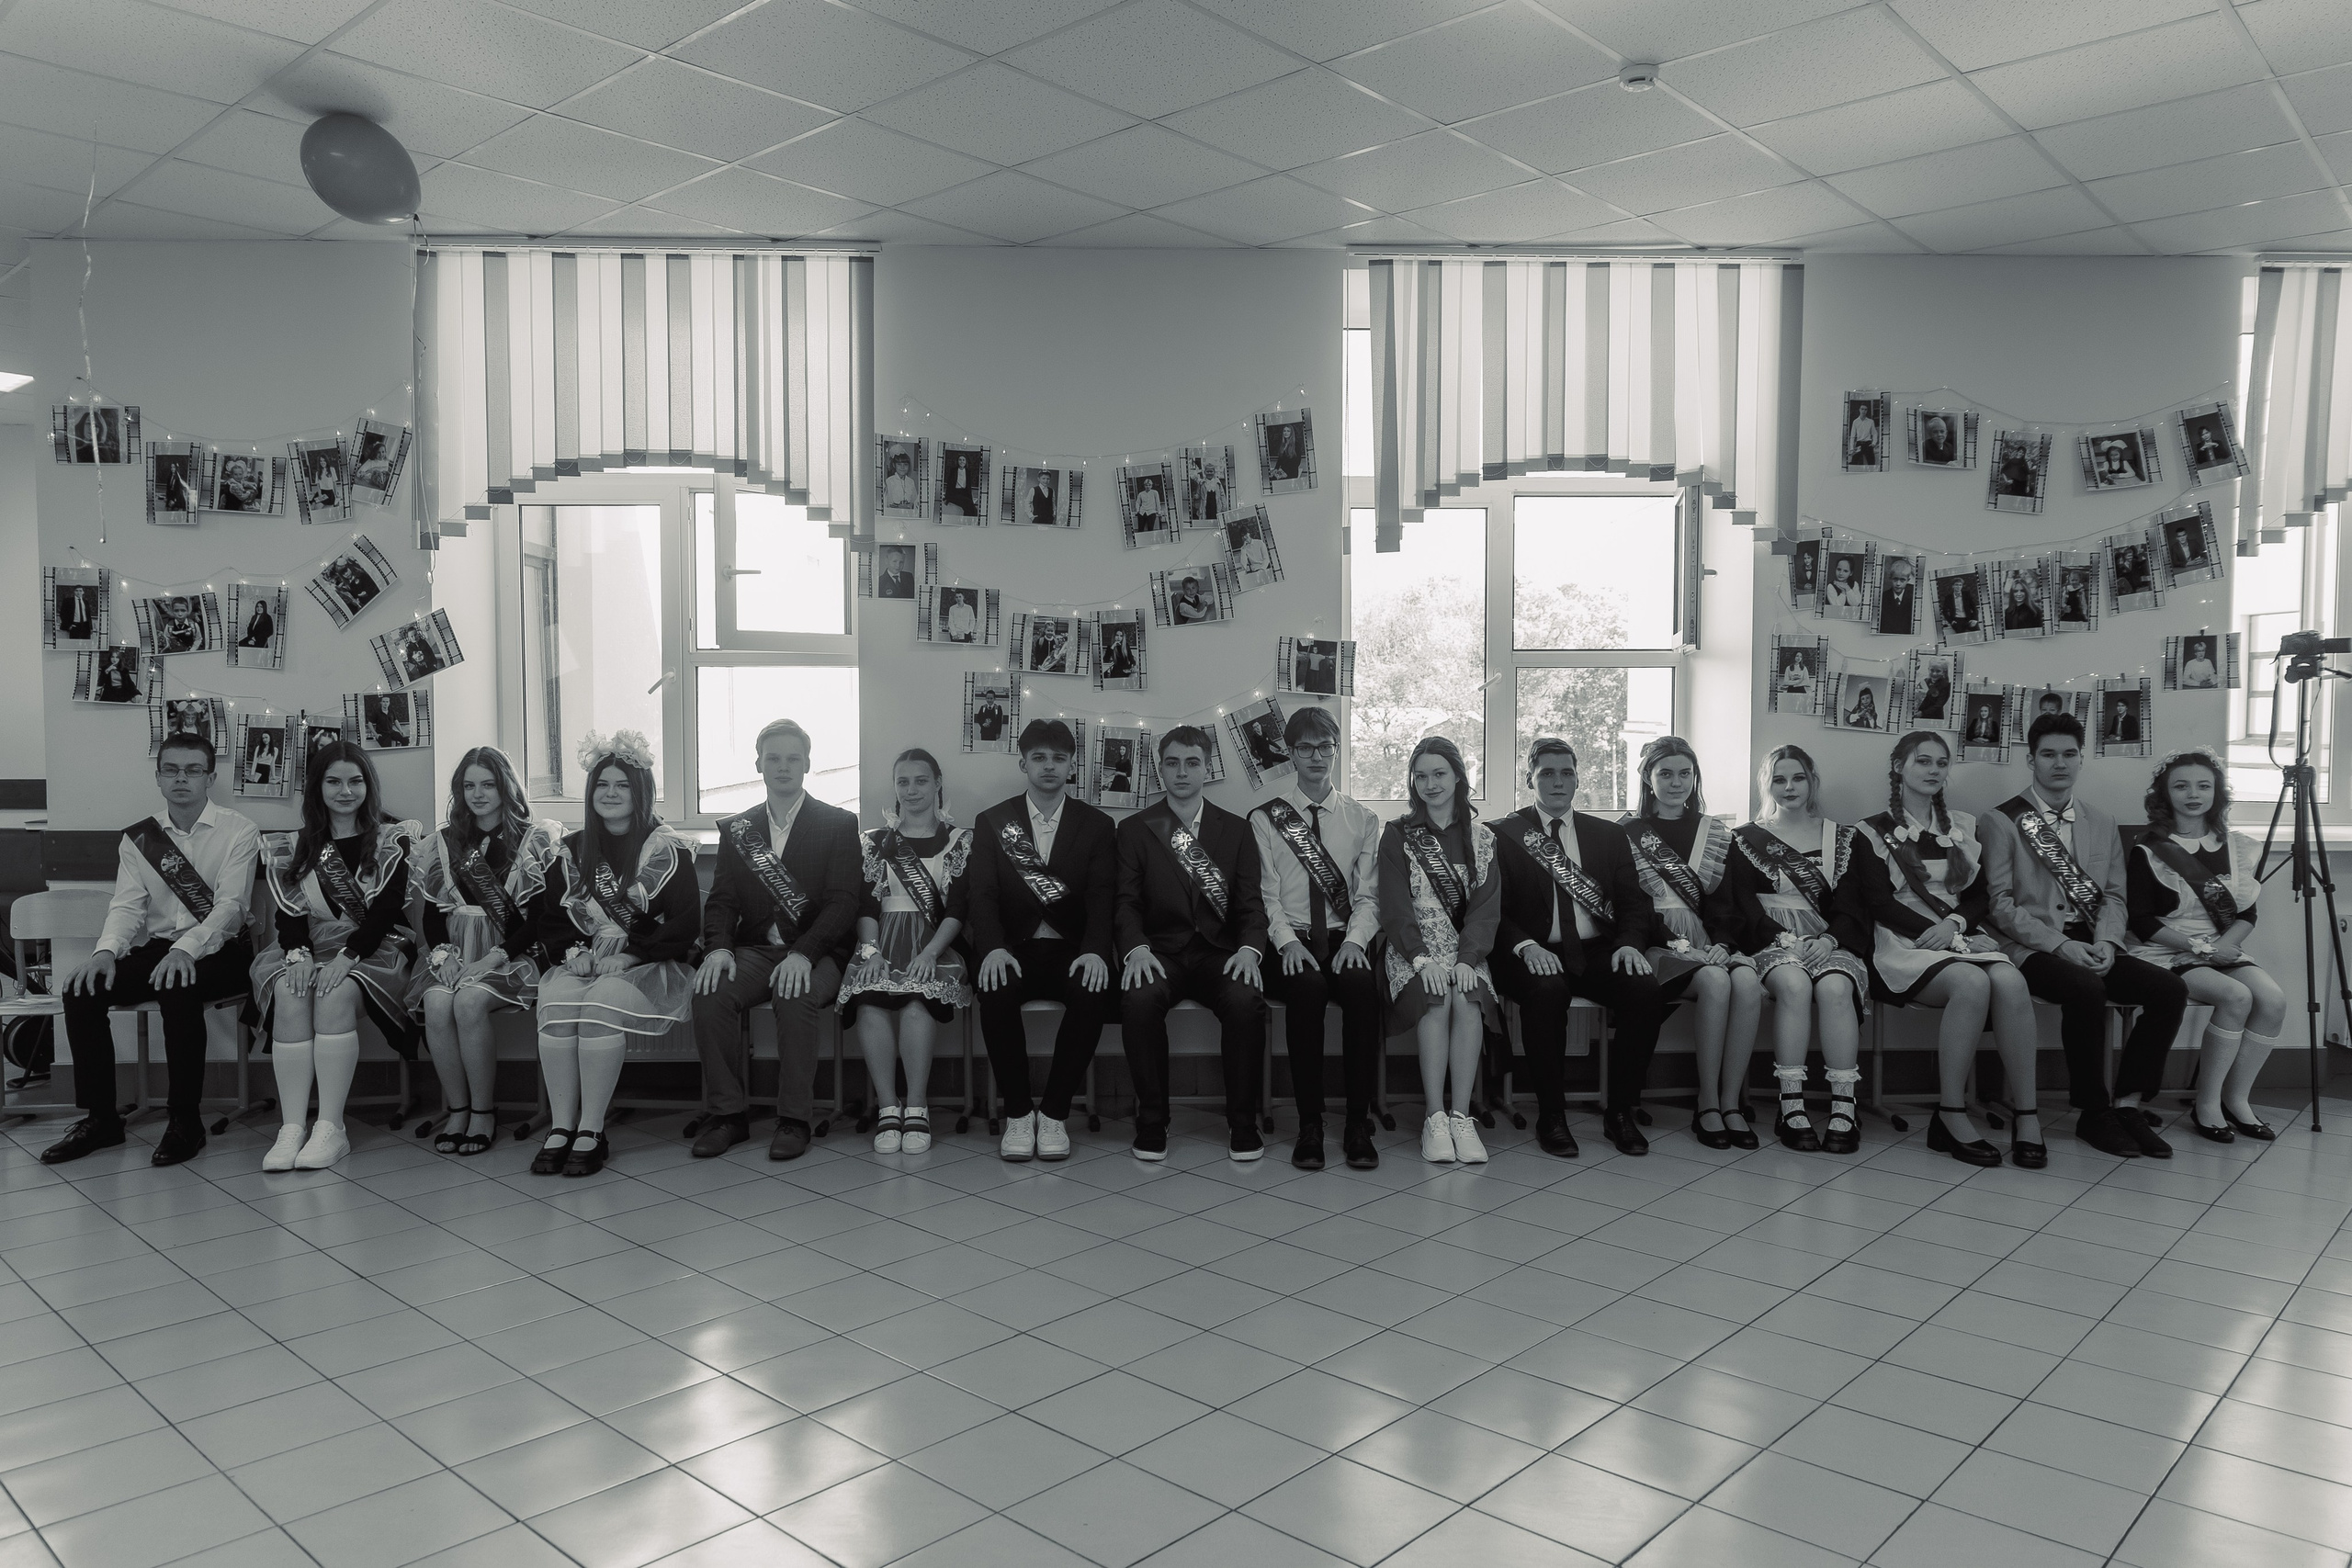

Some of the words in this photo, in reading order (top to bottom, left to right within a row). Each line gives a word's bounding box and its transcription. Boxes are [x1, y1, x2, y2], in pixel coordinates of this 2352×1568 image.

[740, 830, 794, 900] Выпускник
[786, 891, 809, 916] 20
[894, 847, 934, 910] Выпускниц
[1184, 846, 1228, 911] Выпускни
[1283, 818, 1337, 886] Выпускник
[1539, 842, 1603, 906] Выпускник
[1654, 847, 1700, 901] Выпускни
[2034, 830, 2096, 904] Выпускник
[173, 869, 212, 917] Выпус
[322, 857, 366, 925] Выпускниц
